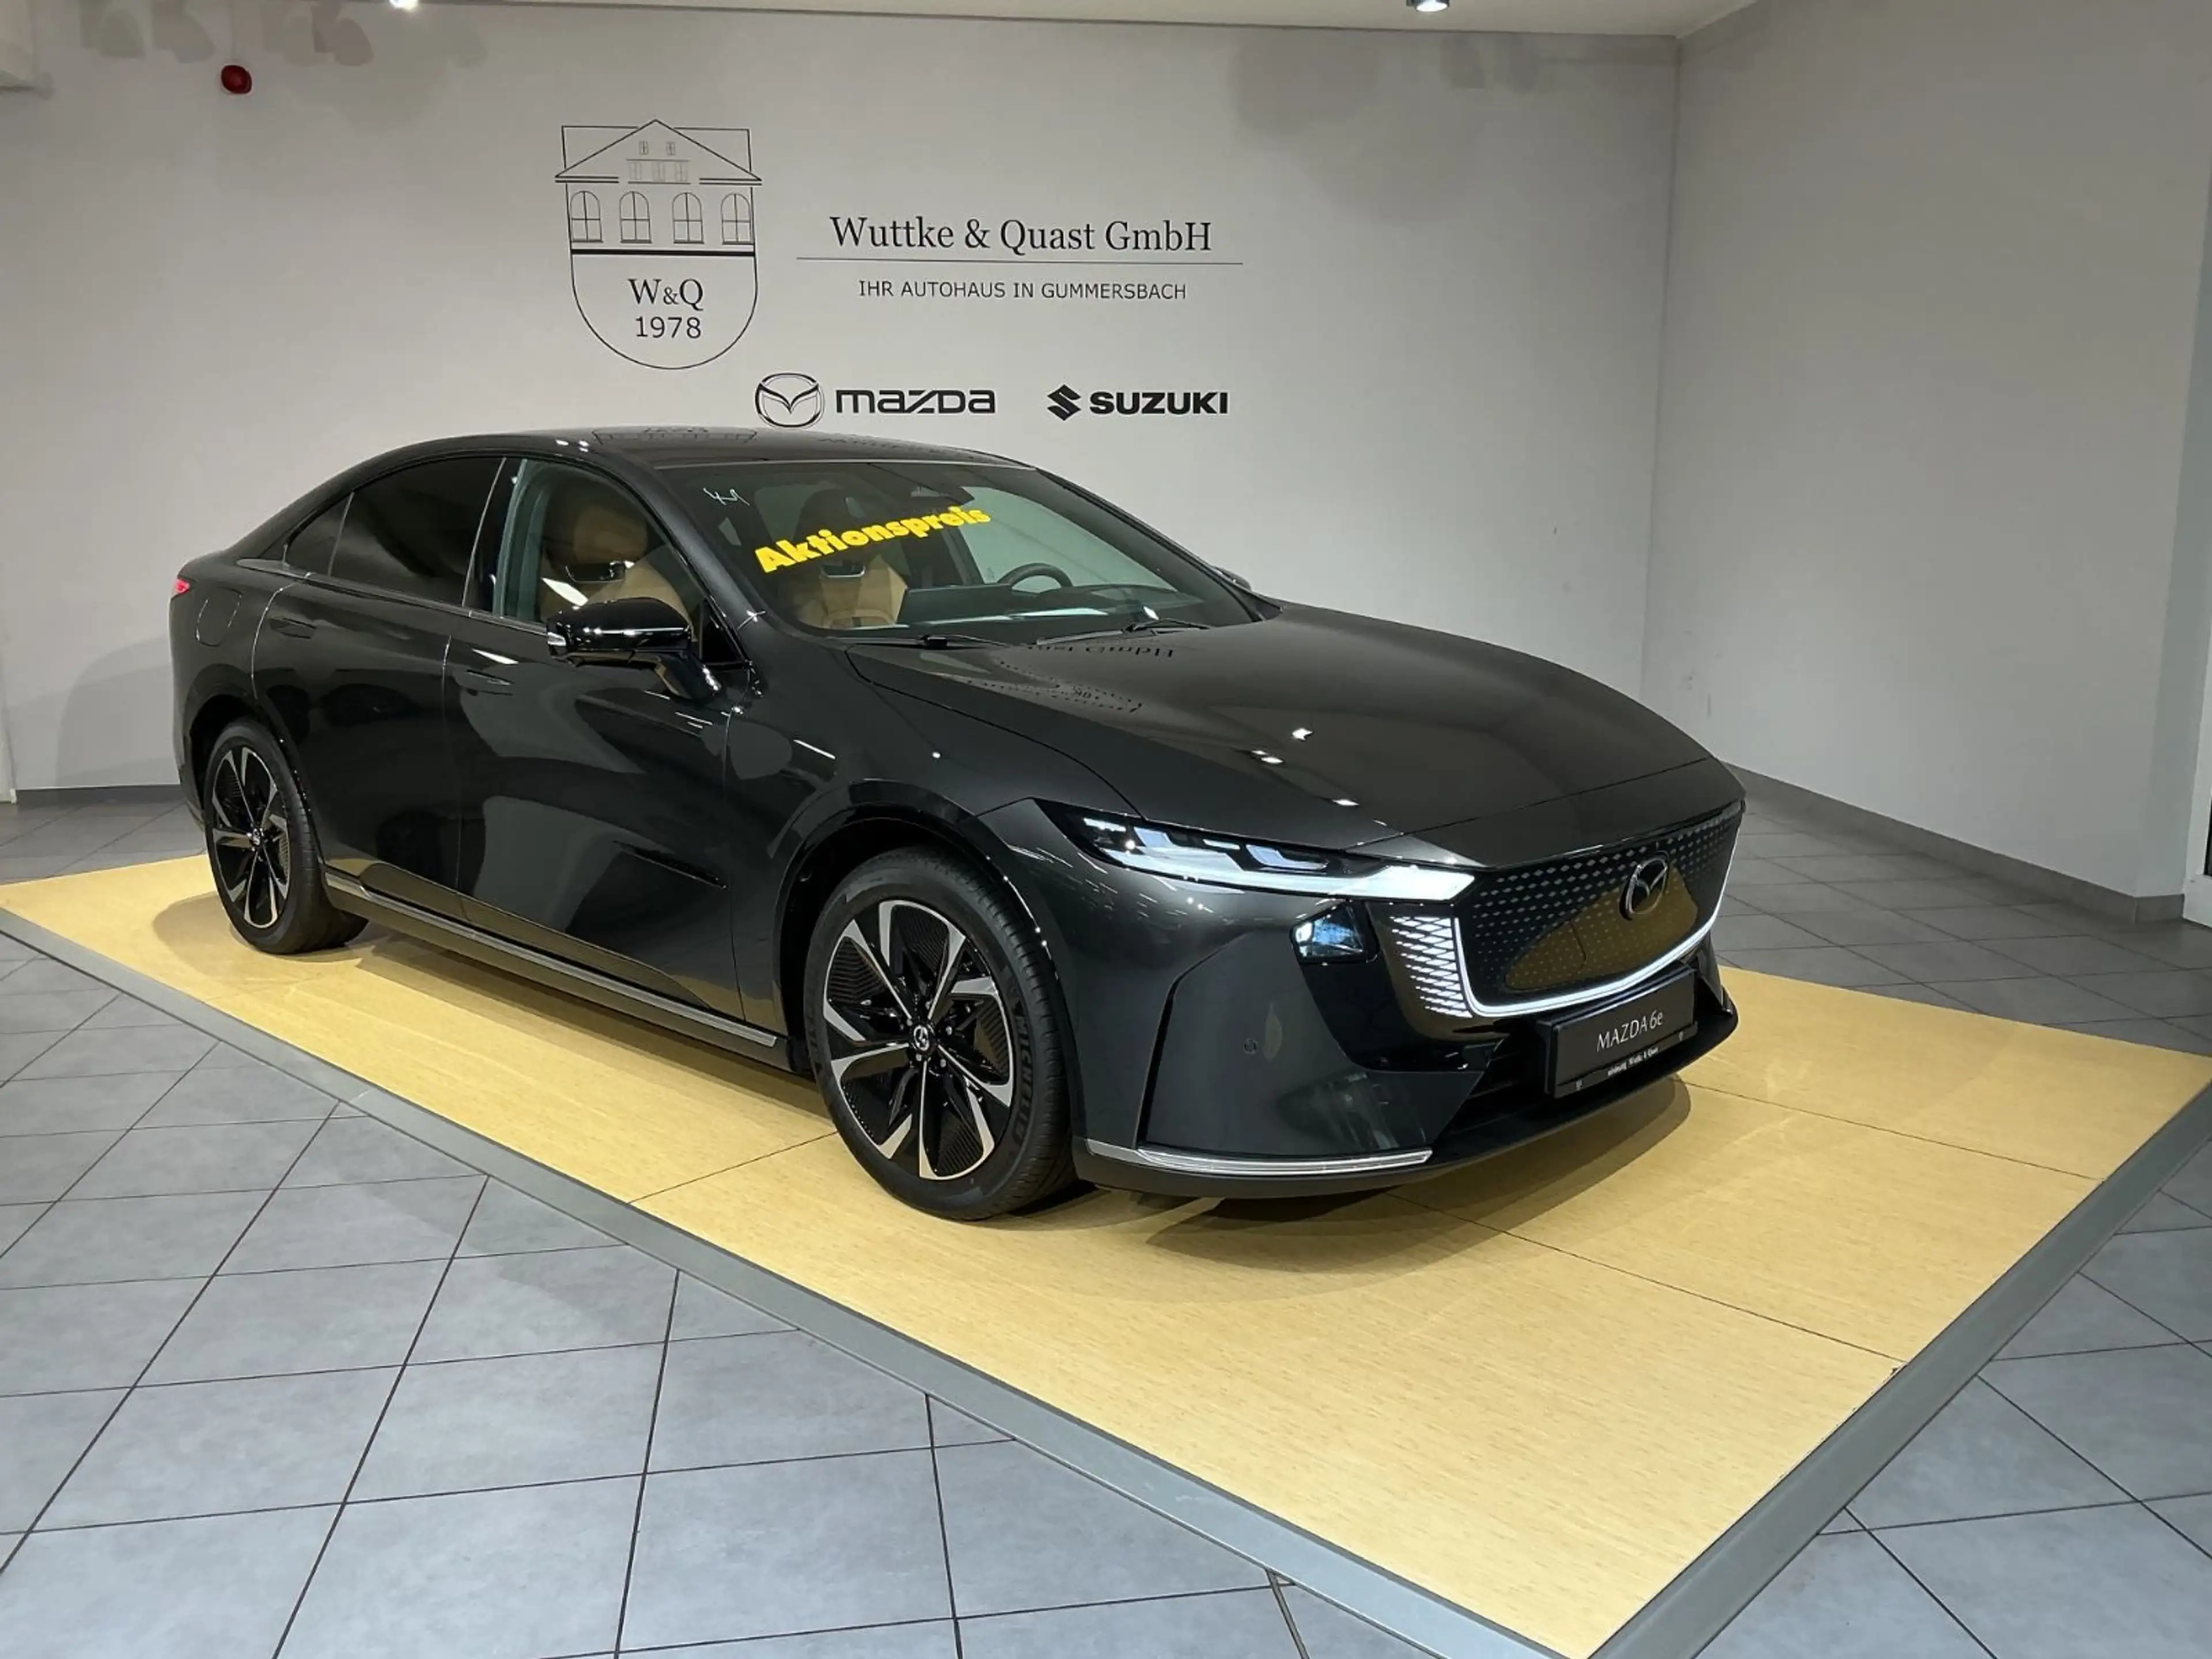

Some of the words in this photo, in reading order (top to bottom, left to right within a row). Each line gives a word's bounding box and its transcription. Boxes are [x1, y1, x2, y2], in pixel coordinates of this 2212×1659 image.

[829, 215, 955, 248] Wuttke
[964, 218, 991, 249] &
[1001, 219, 1096, 256] Quast
[1105, 219, 1212, 251] GmbH
[627, 278, 704, 311] W&Q
[859, 280, 894, 297] IHR
[901, 281, 1006, 298] AUTOHAUS
[1014, 283, 1034, 298] IN
[1041, 283, 1187, 300] GUMMERSBACH
[635, 316, 702, 339] 1978
[1089, 391, 1229, 415] SUZUKI
[755, 505, 991, 573] Aktionspreis
[1596, 1016, 1647, 1053] MAZDA
[1649, 1009, 1663, 1029] 6e
